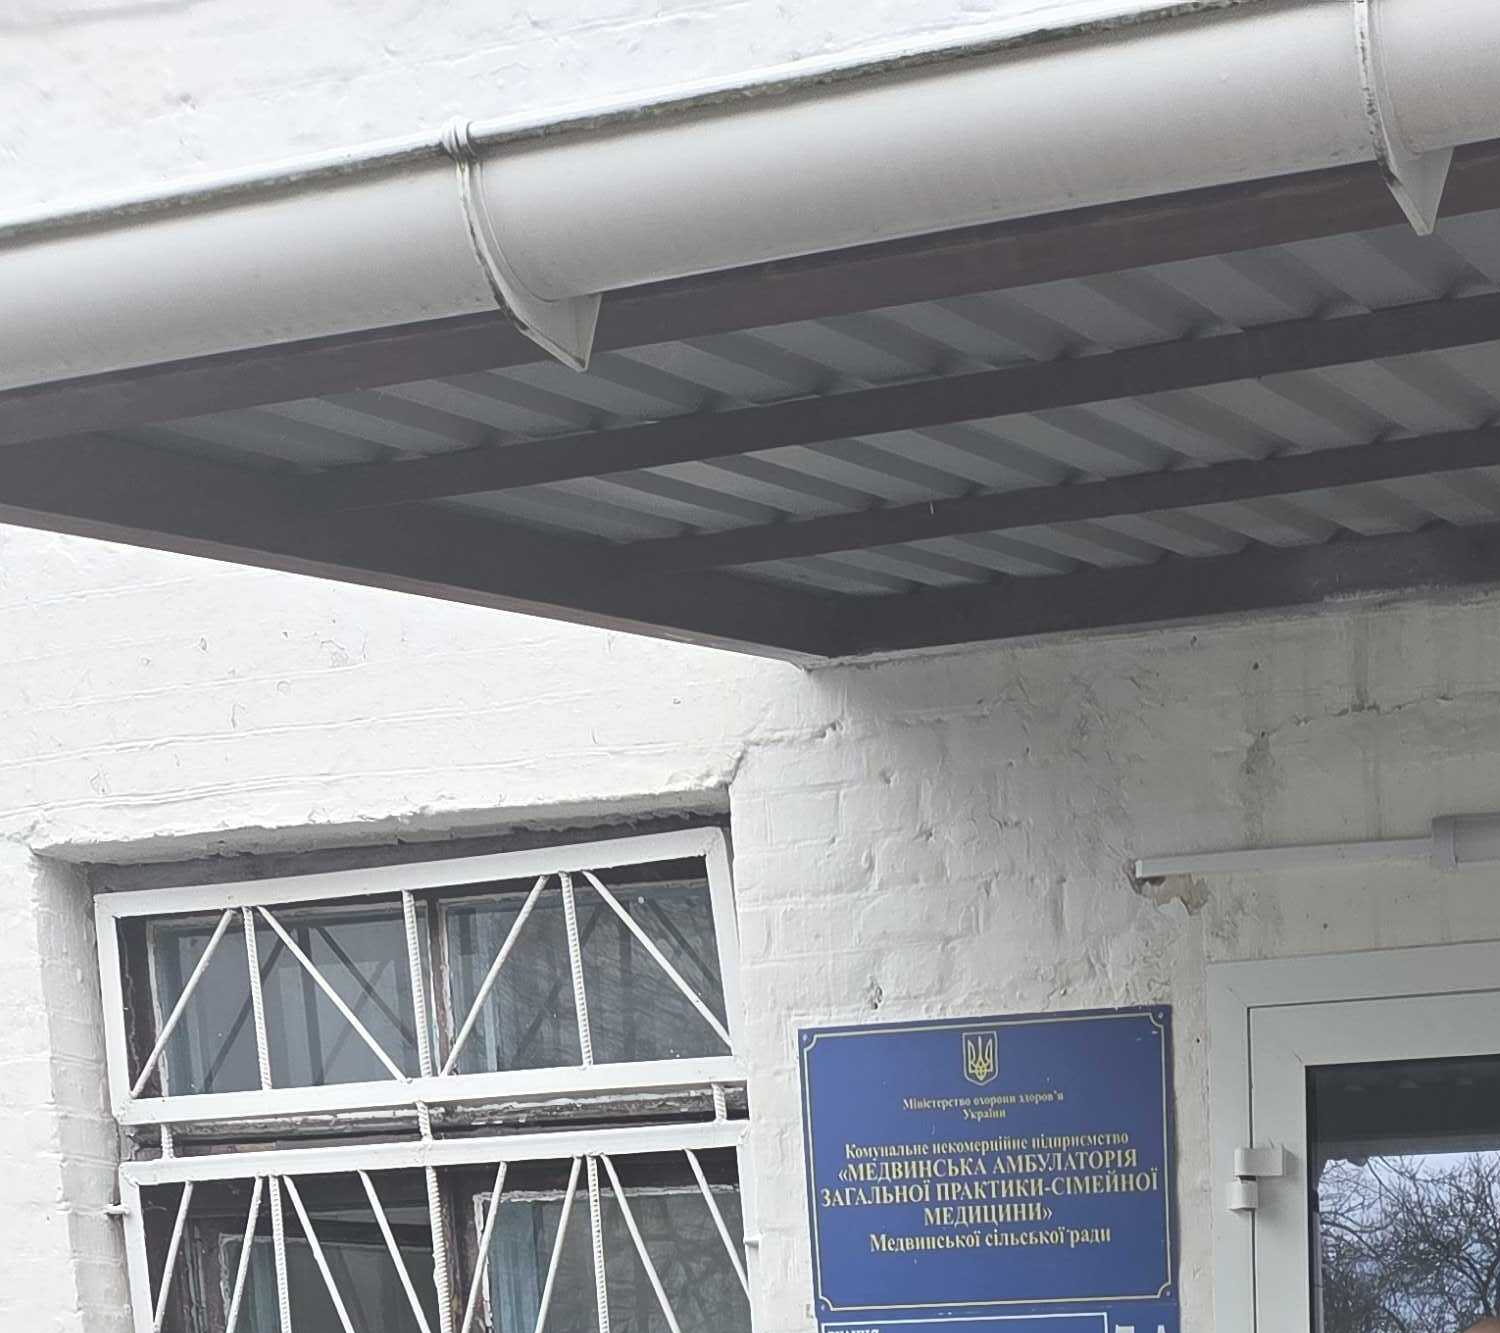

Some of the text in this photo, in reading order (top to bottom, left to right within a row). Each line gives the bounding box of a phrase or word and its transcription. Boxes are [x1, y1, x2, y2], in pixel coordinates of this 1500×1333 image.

[903, 1097, 971, 1111] Міністерство
[973, 1093, 1016, 1107] охорони
[962, 1108, 1006, 1121] України
[845, 1132, 1129, 1160] Комунальне некомерційне підприємство
[838, 1148, 1137, 1184] «МЕДВИНСЬКА АМБУЛАТОРІЯ
[820, 1167, 1158, 1207] ЗАГАЛЬНОЇ ПРАКТИКИ-СІМЕЙНОЇ
[923, 1203, 1053, 1229] МЕДИЦИНИ»
[869, 1227, 1111, 1253] Медвинської сільської ради
